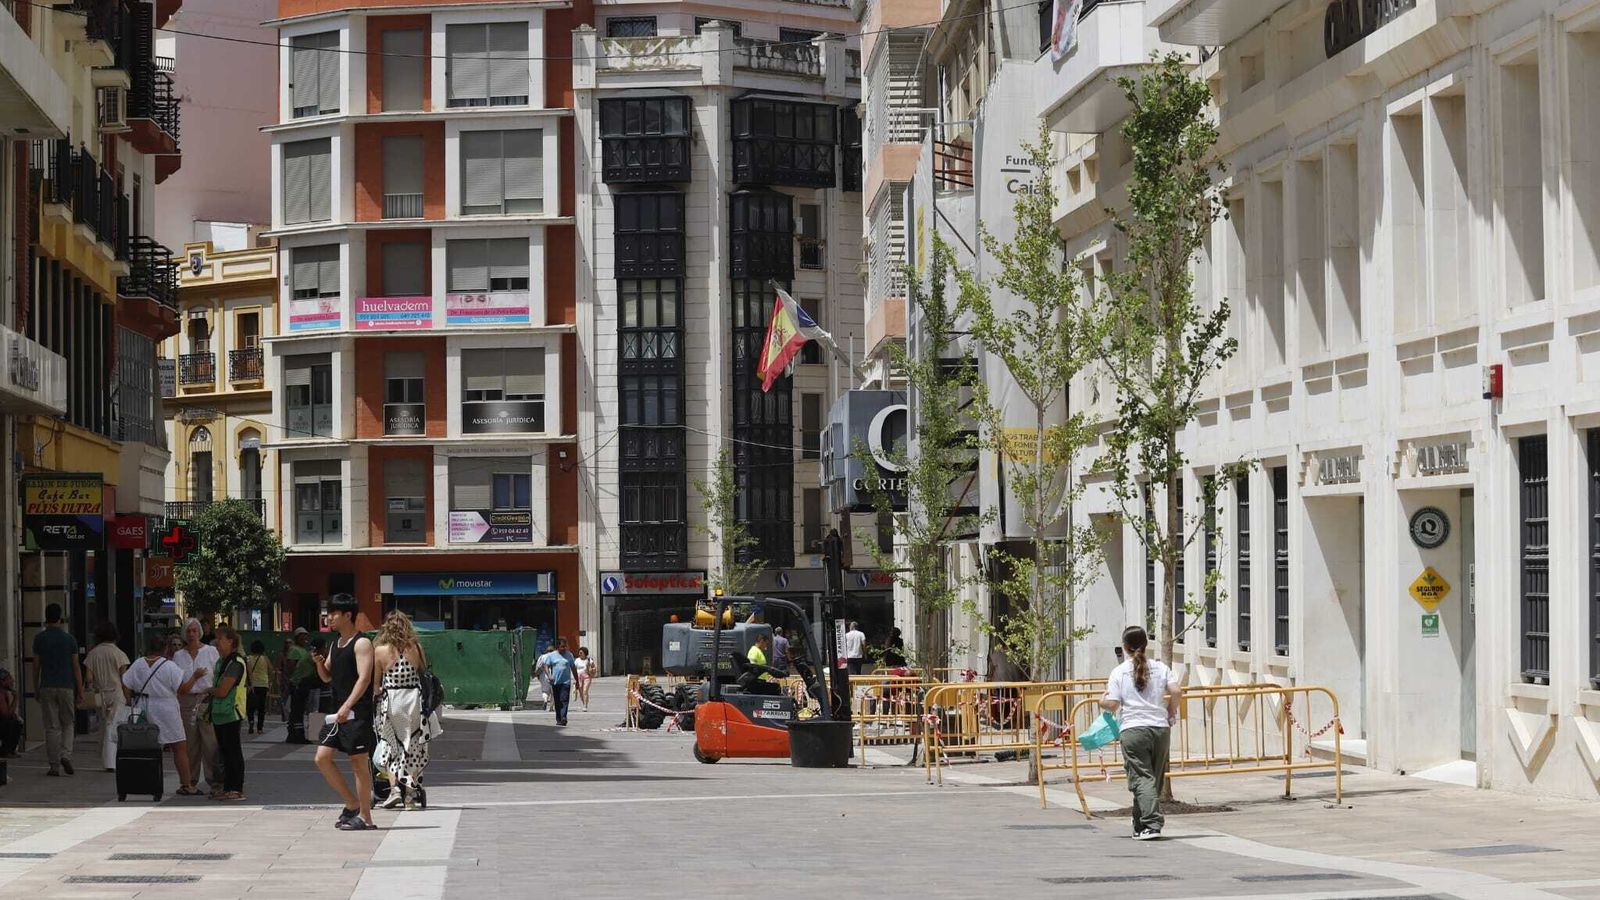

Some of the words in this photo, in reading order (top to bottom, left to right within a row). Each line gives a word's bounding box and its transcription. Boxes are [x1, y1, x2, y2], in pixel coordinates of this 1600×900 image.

[362, 300, 429, 312] huelvaderm
[27, 503, 59, 513] PLUS
[61, 503, 101, 513] ULTRA
[43, 526, 77, 535] RETA
[116, 527, 144, 536] GAES
[456, 580, 493, 588] movistar
